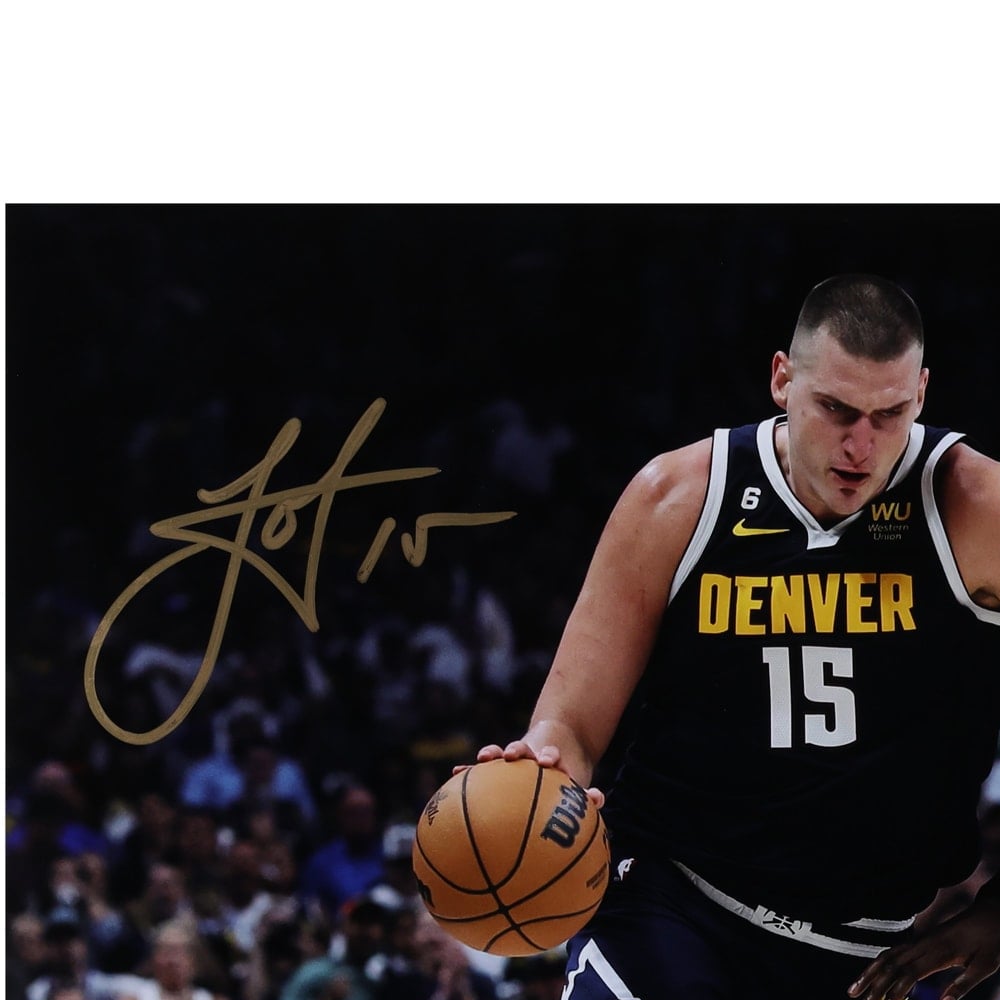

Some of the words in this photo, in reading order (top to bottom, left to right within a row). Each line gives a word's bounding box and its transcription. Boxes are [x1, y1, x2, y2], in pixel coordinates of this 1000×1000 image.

[740, 486, 762, 510] 6
[871, 501, 911, 521] WU
[868, 523, 909, 532] Western
[873, 532, 902, 540] Union
[698, 573, 917, 635] DENVER
[762, 645, 857, 749] 15
